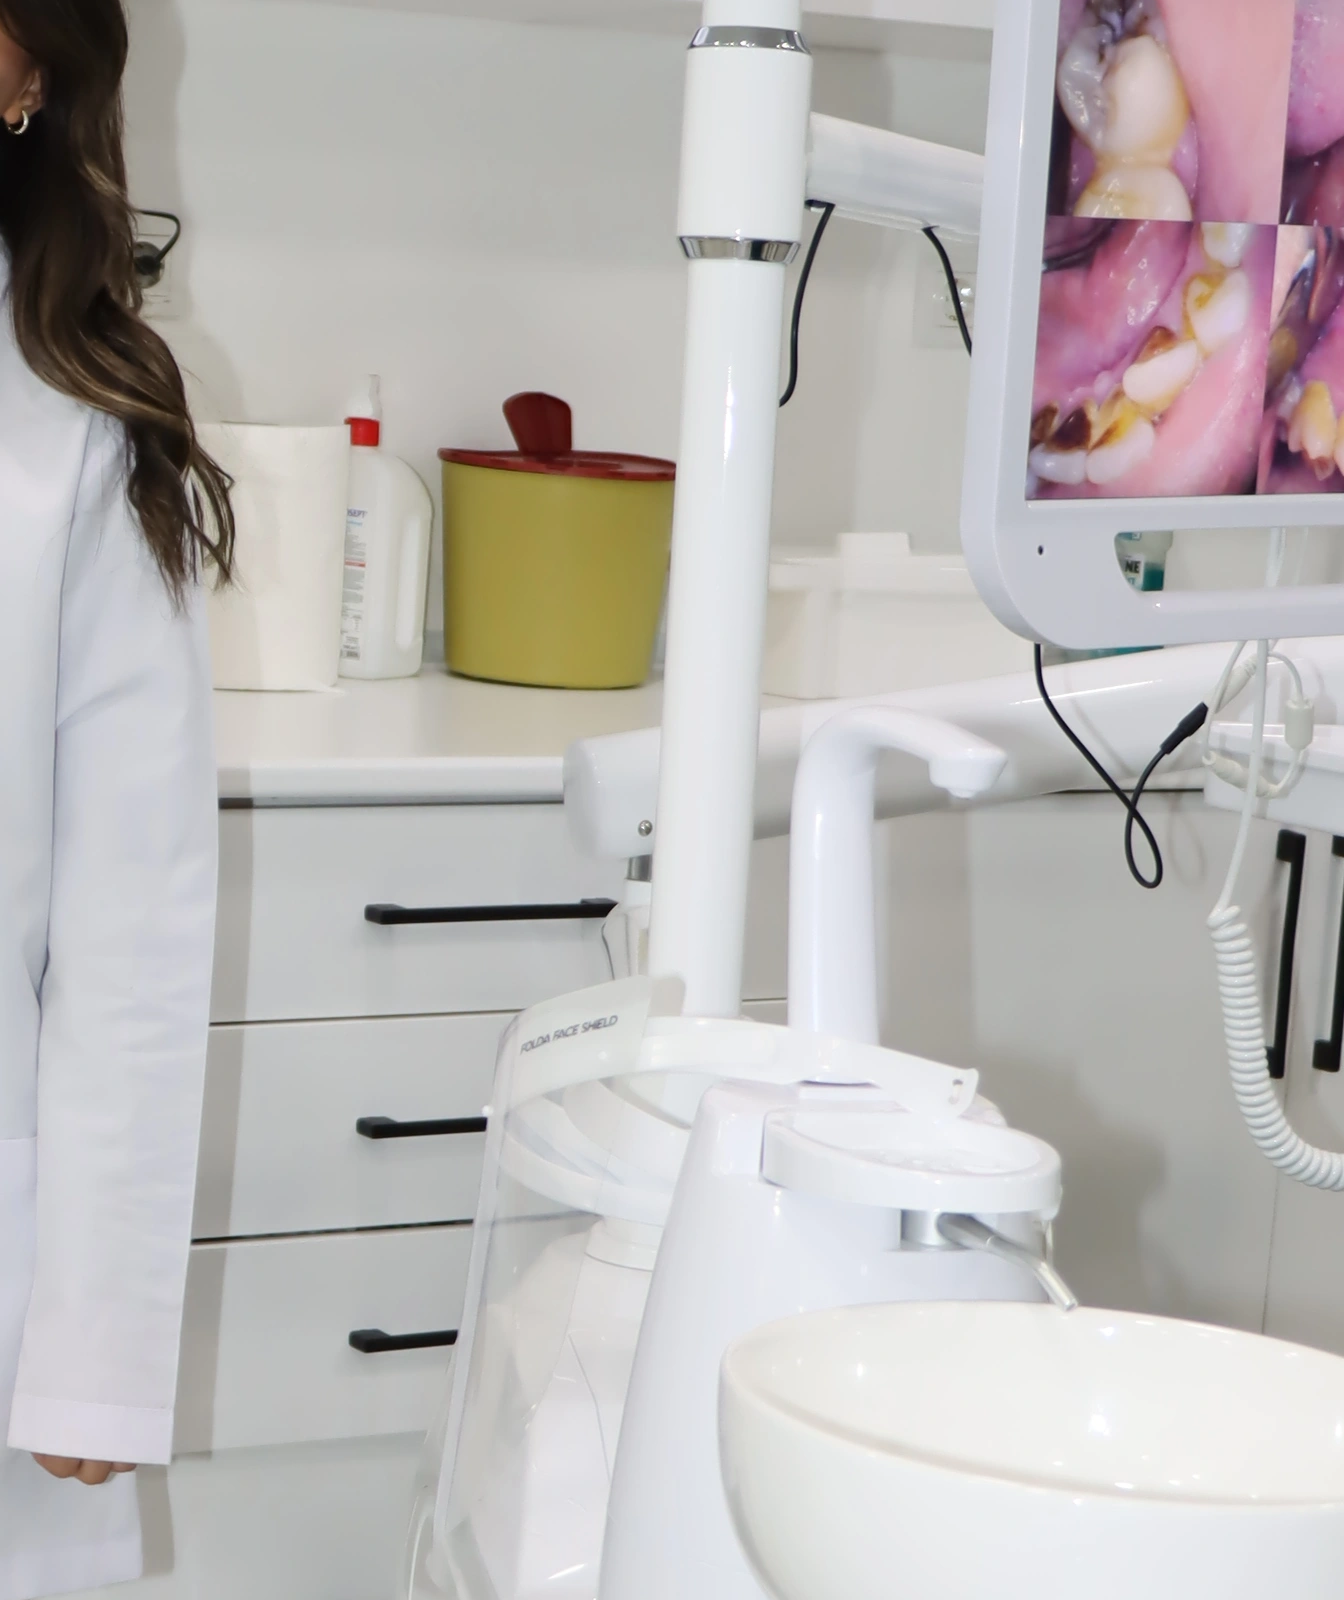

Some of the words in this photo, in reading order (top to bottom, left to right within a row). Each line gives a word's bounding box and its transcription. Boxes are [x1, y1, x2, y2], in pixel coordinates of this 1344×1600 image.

[520, 1034, 550, 1056] FOLDA
[552, 1024, 581, 1041] FACE
[581, 1014, 619, 1033] SHIELD
